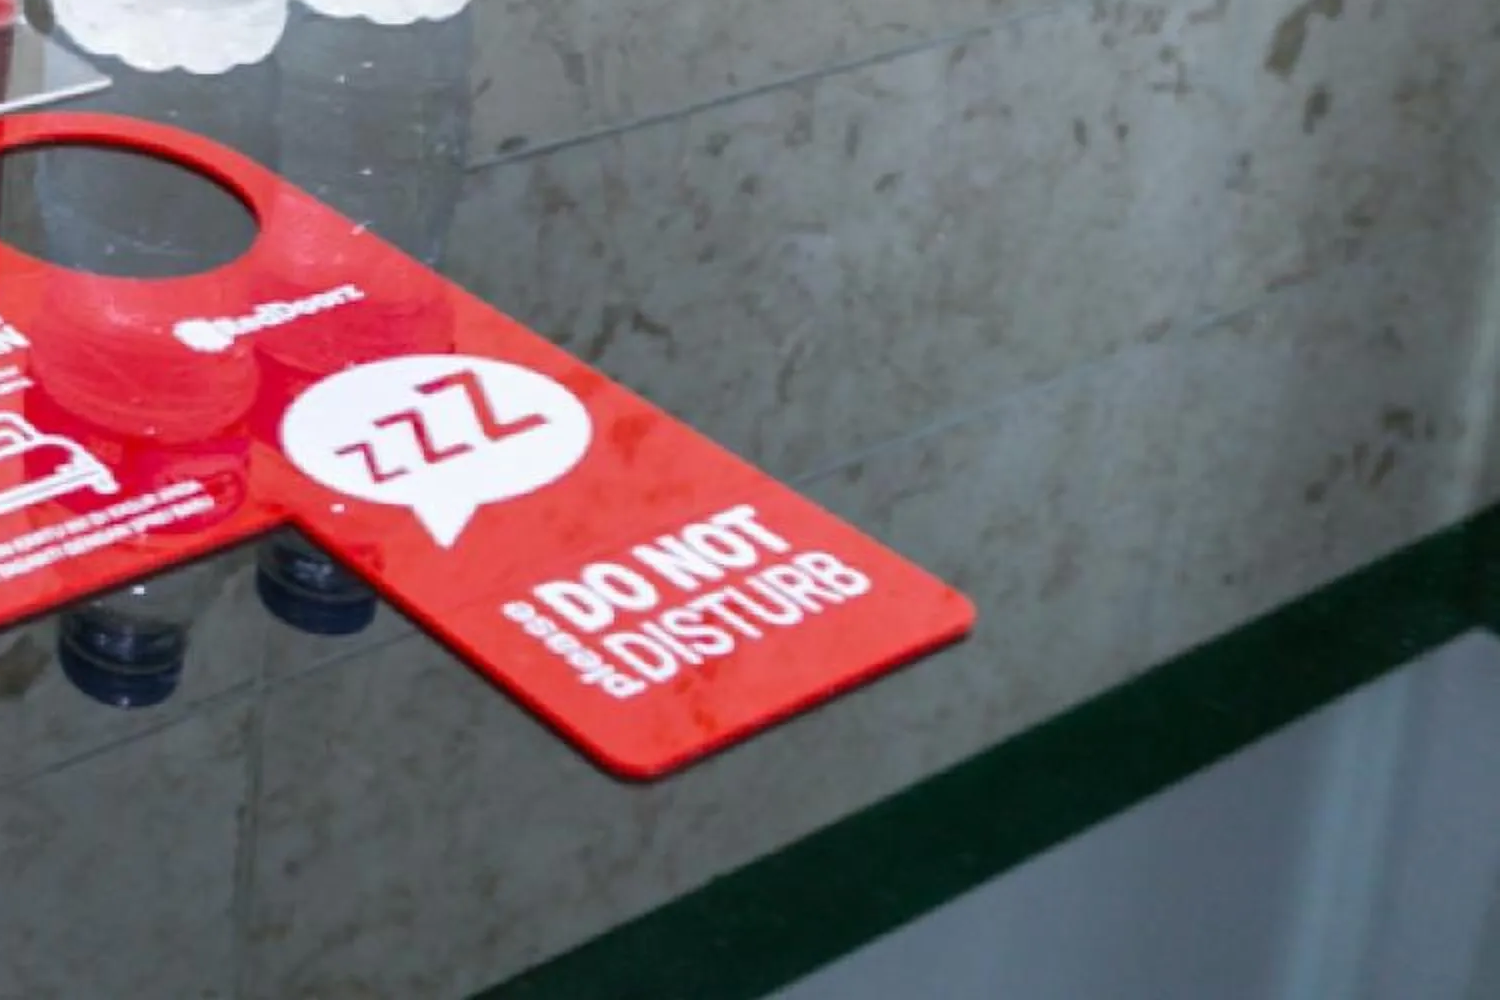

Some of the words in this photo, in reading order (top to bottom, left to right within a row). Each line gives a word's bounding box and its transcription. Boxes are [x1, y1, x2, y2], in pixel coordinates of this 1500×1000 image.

[532, 560, 661, 633] DO
[630, 503, 791, 592] NOT
[601, 551, 873, 683] DISTURB
